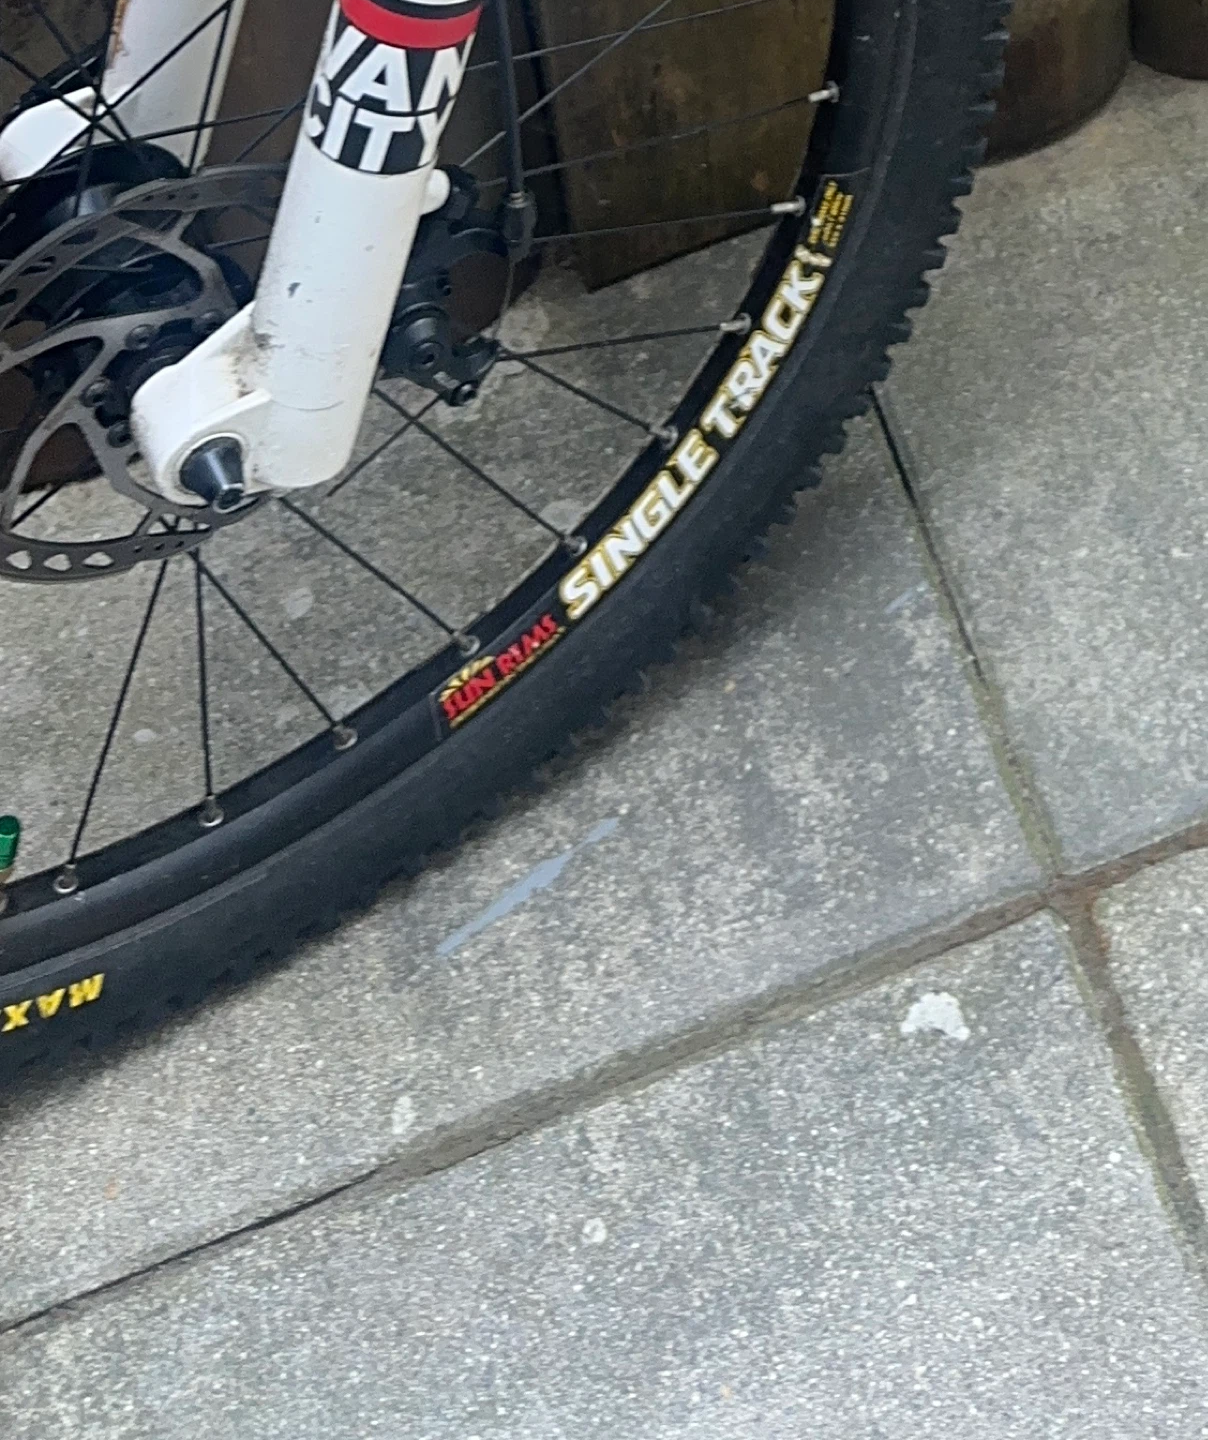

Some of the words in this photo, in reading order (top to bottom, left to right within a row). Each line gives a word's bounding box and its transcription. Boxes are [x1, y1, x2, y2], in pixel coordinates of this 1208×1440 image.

[318, 2, 477, 113] VAN
[303, 73, 457, 175] CITY
[443, 666, 497, 720] SUN
[558, 427, 720, 621] SINGLE
[699, 259, 825, 439] TRACK
[0, 973, 105, 1032] MAX
